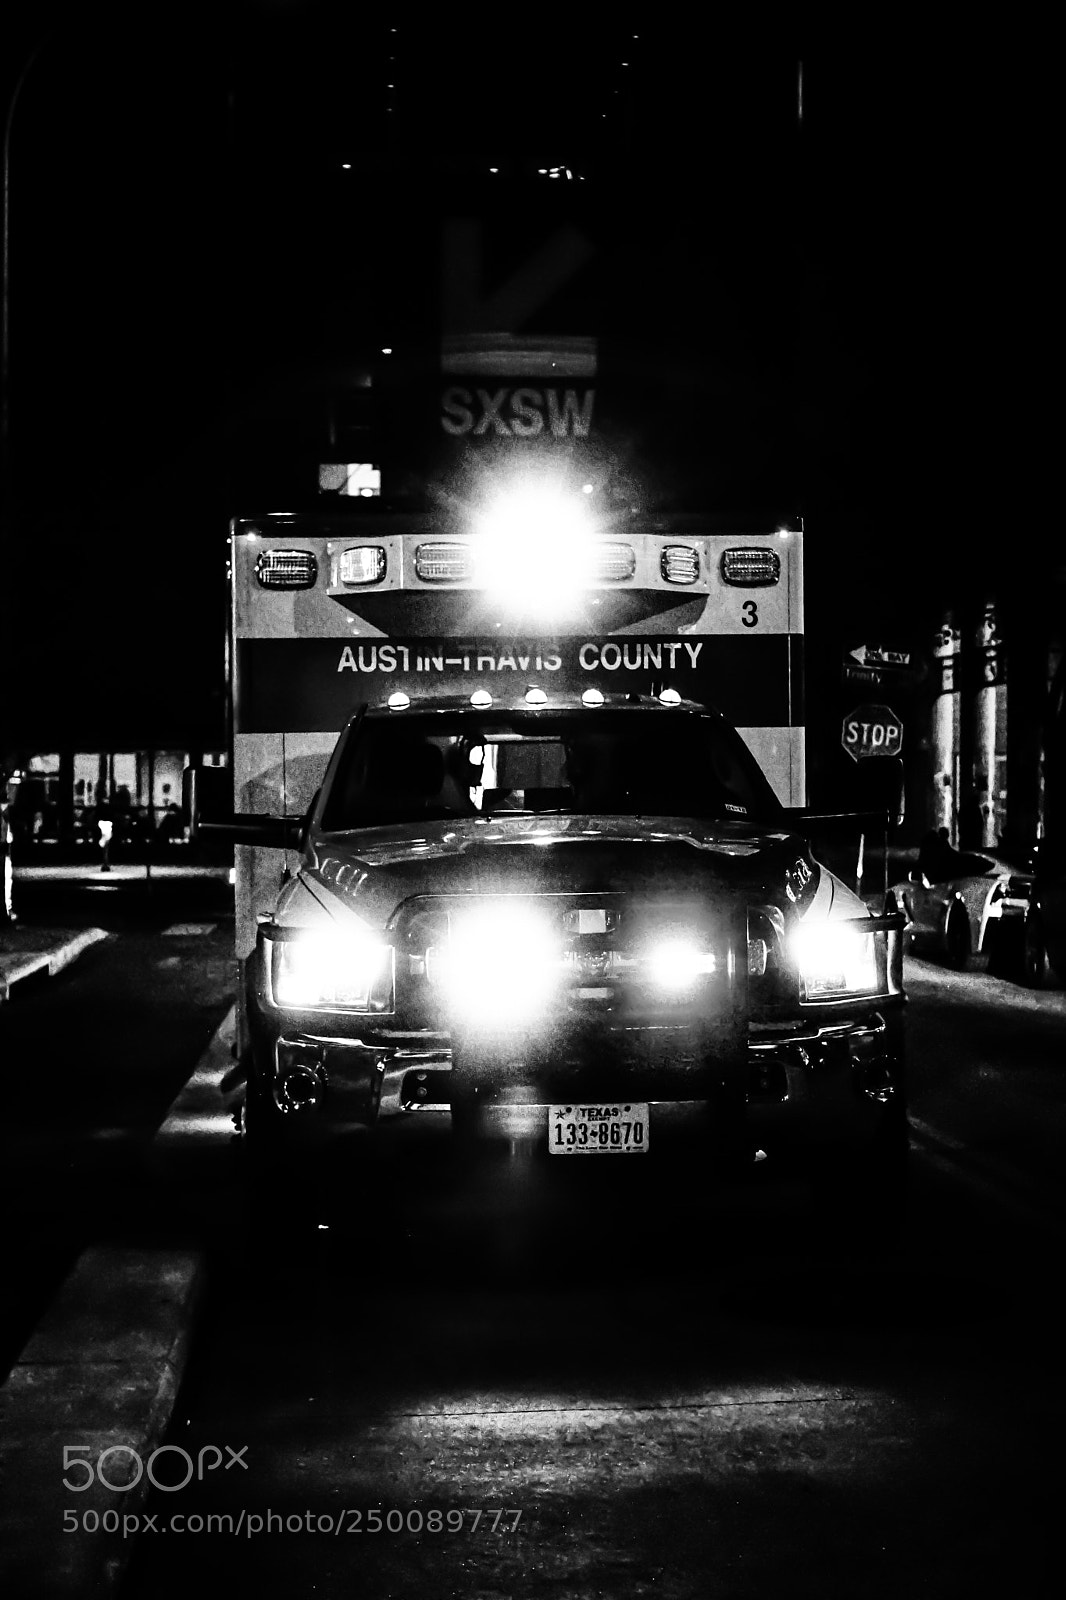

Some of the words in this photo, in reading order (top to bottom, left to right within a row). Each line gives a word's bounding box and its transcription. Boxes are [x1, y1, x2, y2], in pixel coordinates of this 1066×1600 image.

[440, 386, 596, 438] SXSW
[741, 600, 758, 628] 3
[337, 644, 562, 672] AUSTIN-TRAVIS
[579, 642, 703, 671] COUNTY
[846, 721, 899, 747] STOP
[579, 1107, 619, 1117] TEXAS
